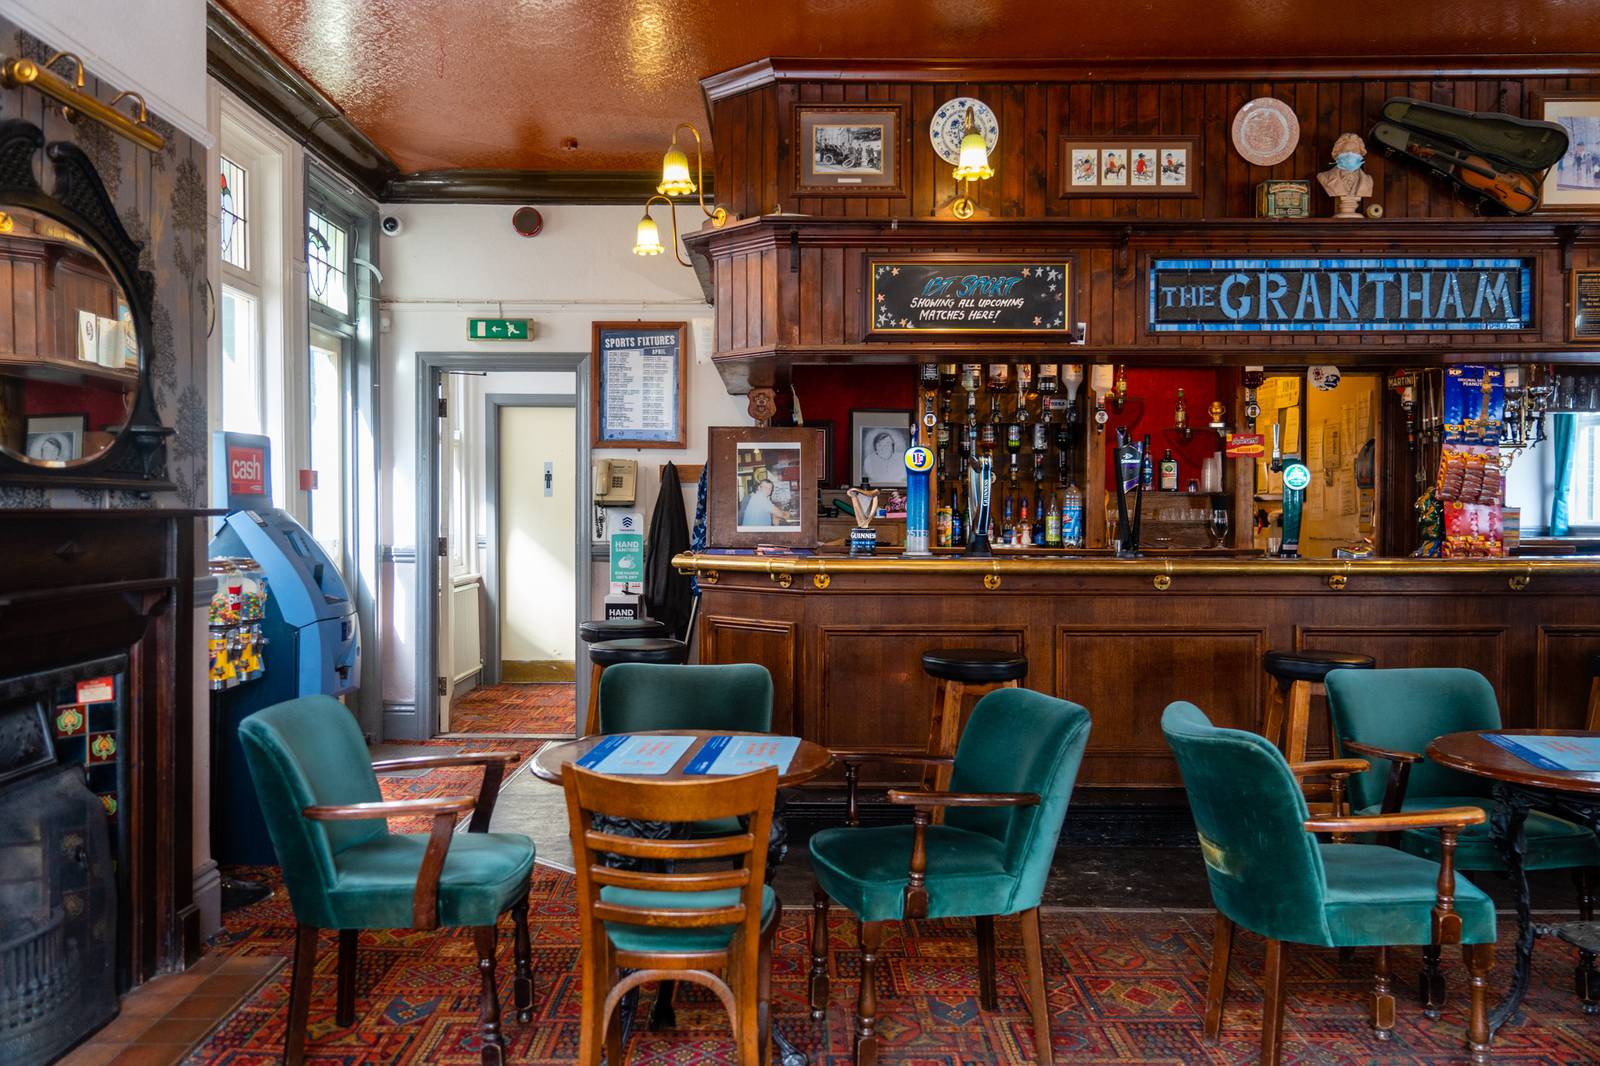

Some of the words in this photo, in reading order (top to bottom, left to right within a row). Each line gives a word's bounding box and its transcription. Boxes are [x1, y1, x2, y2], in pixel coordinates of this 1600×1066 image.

[922, 275, 956, 297] BT
[956, 274, 1024, 298] SPORT
[1161, 286, 1218, 307] THE
[1219, 272, 1515, 319] GRANTHAM
[909, 297, 955, 309] SHOWING
[958, 298, 975, 308] ALL
[978, 298, 1025, 309] UPCOMING
[918, 310, 965, 321] MATCHES
[967, 310, 1002, 323] HERE!
[605, 337, 635, 349] SPORTS
[637, 335, 676, 347] FIXTURES
[1448, 368, 1462, 376] KP
[231, 455, 261, 480] cash
